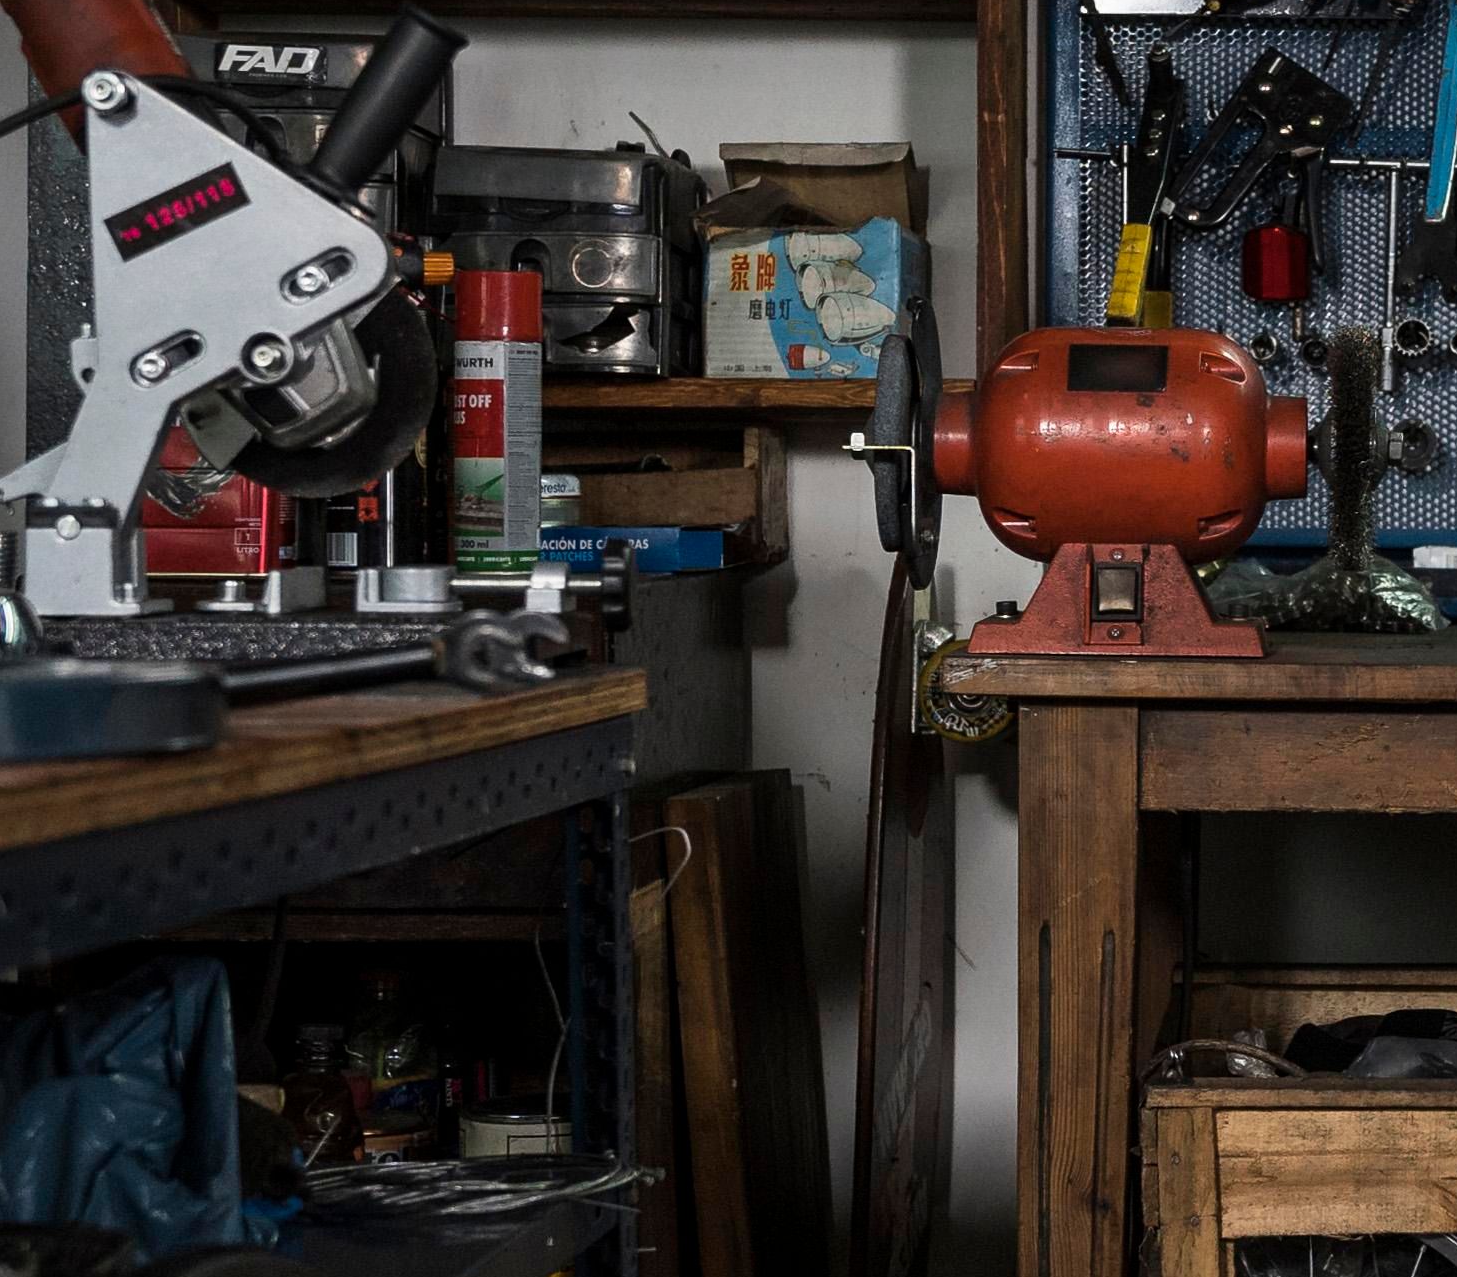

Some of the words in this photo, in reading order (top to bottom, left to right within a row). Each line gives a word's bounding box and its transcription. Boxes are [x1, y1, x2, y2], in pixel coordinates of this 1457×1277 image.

[468, 394, 493, 408] OFF
[477, 539, 489, 549] ml
[579, 538, 594, 550] DE
